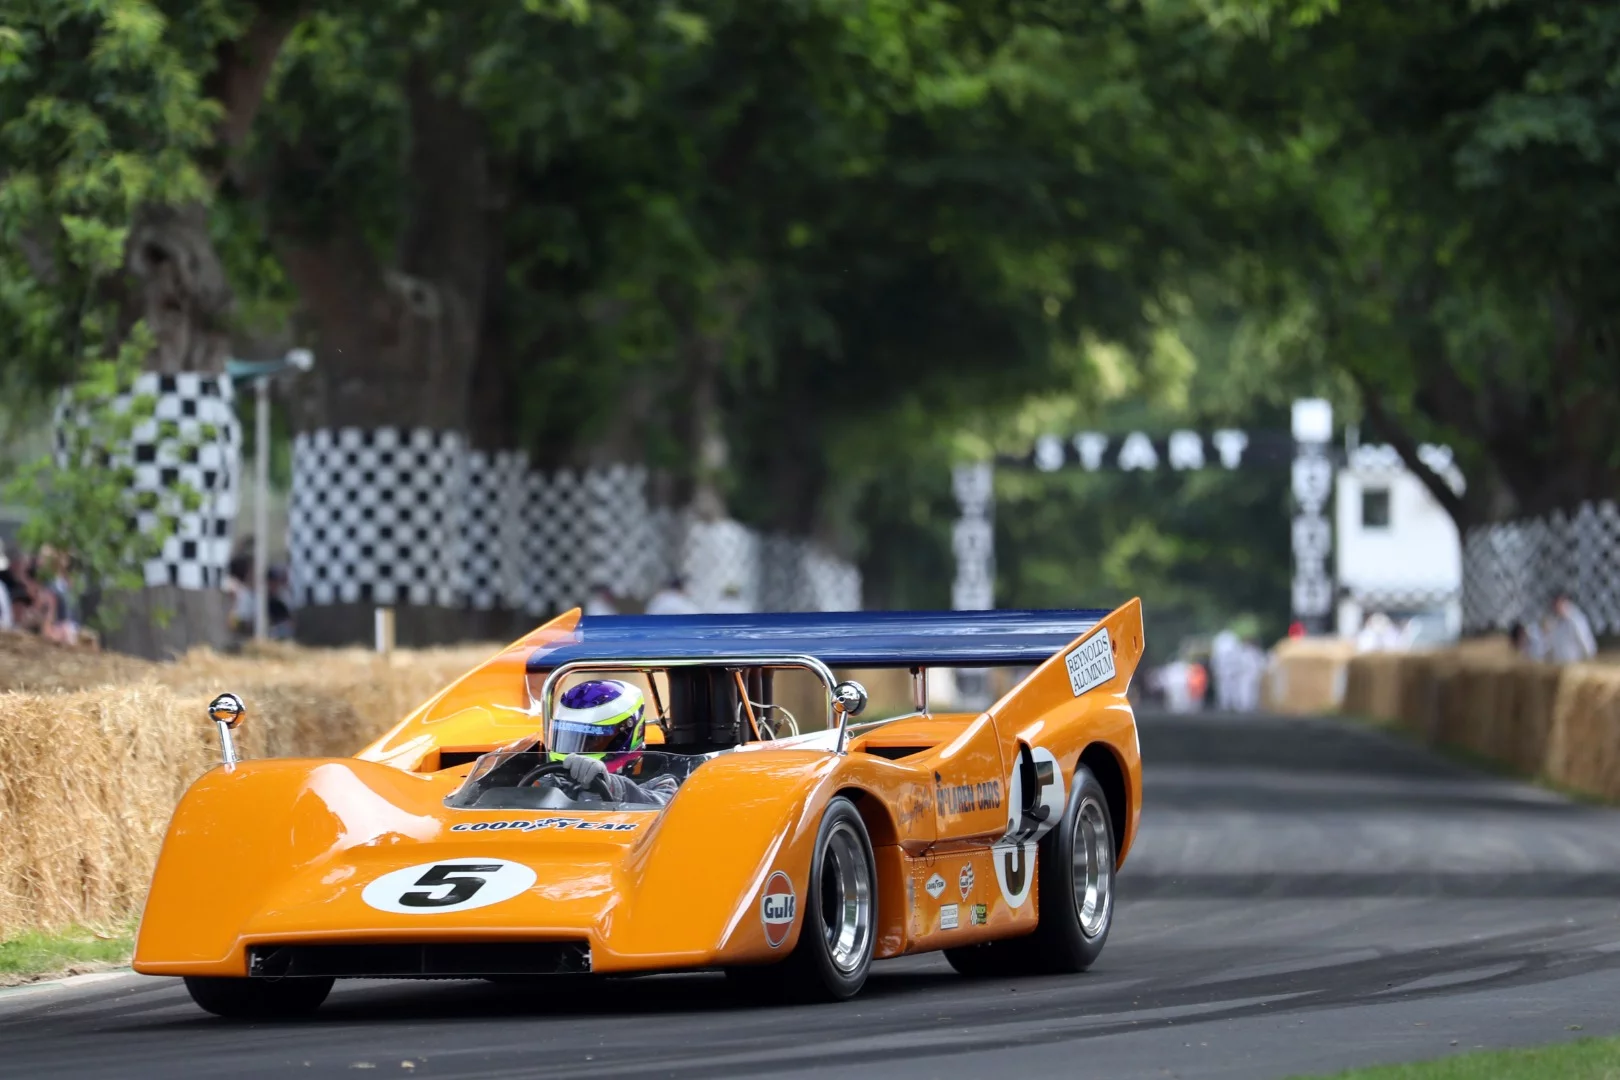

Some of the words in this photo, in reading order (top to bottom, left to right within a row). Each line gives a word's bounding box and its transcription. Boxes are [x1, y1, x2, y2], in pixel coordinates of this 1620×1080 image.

[1034, 429, 1249, 473] START
[1067, 635, 1109, 674] REYNOLDS
[1073, 654, 1113, 692] ALUMINUM
[976, 780, 1000, 810] CARS
[398, 864, 504, 908] 5
[764, 896, 795, 919] Gulf
